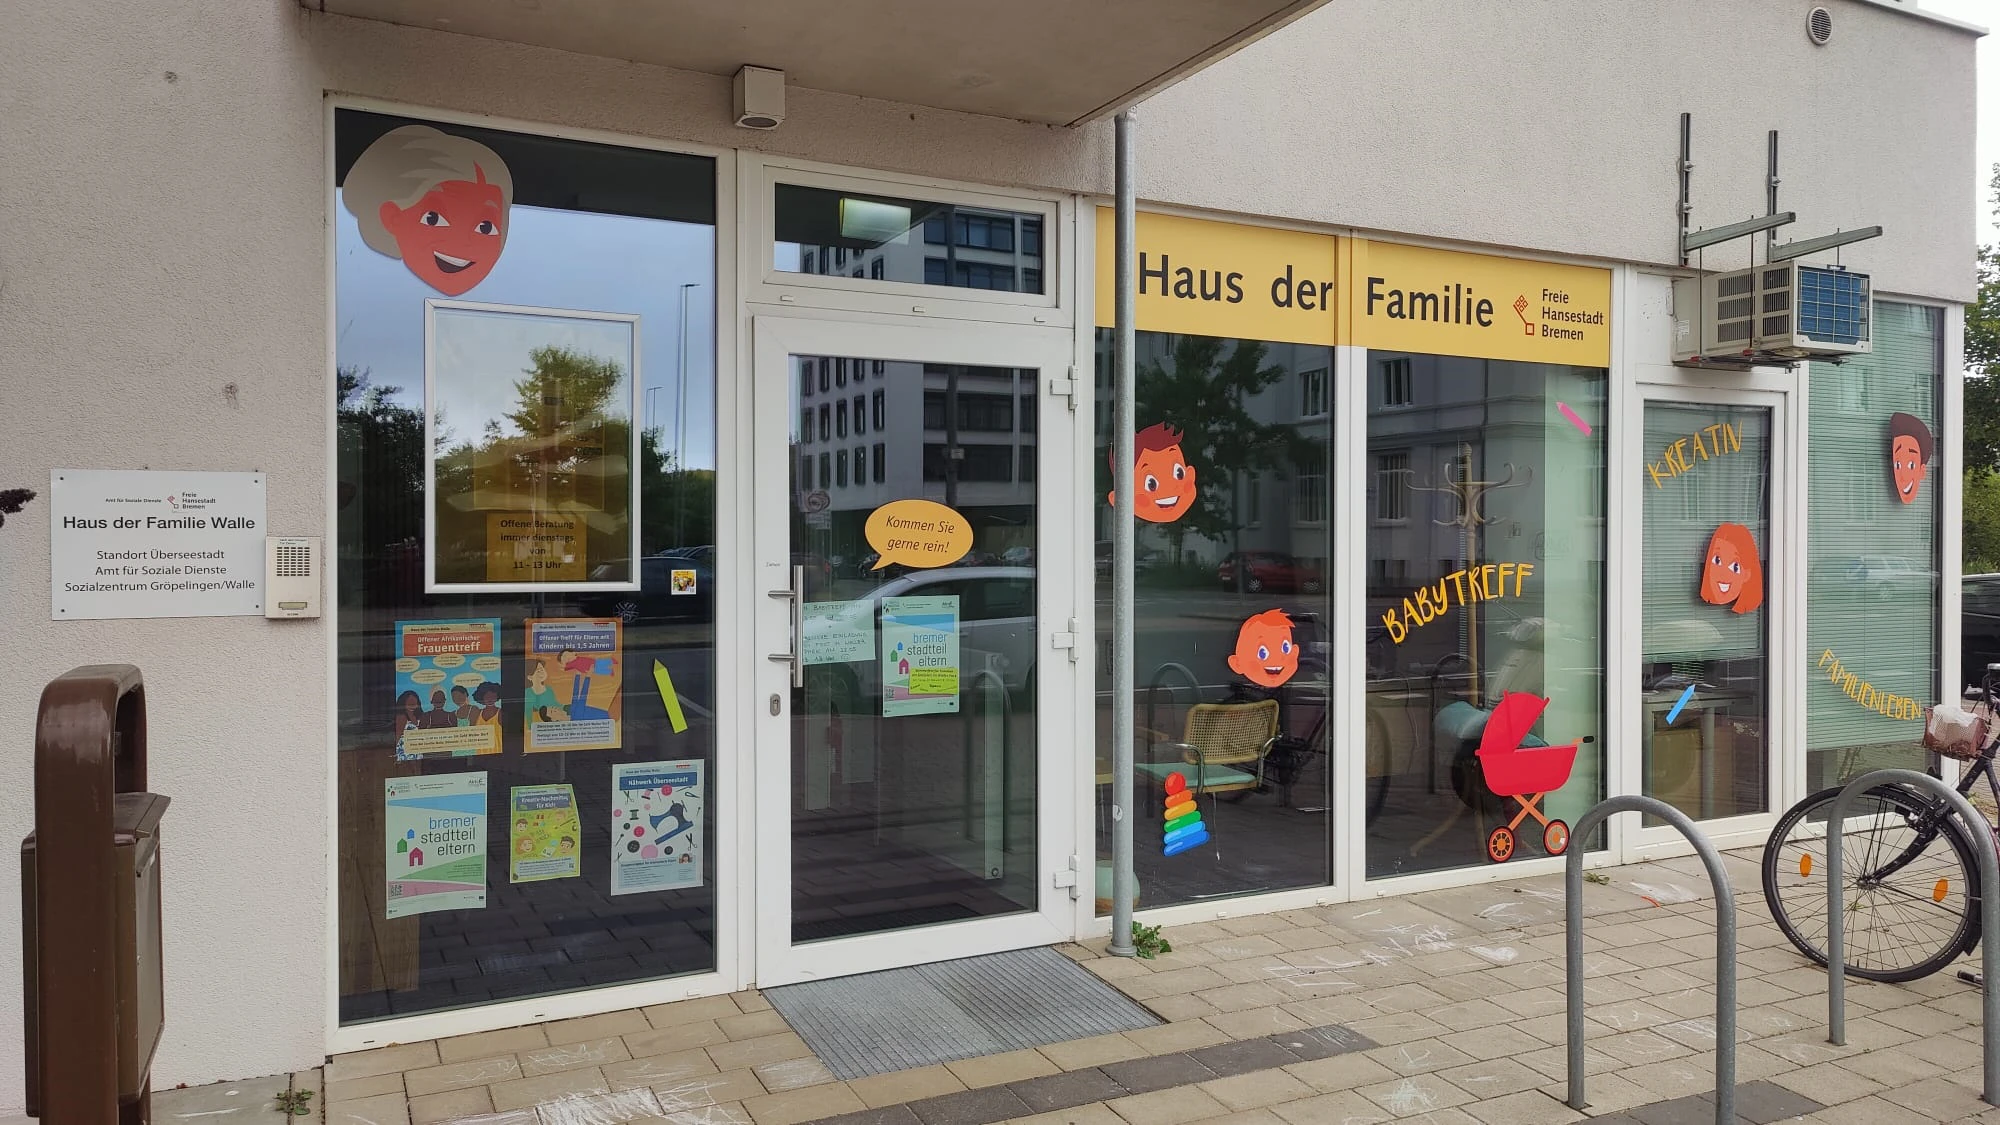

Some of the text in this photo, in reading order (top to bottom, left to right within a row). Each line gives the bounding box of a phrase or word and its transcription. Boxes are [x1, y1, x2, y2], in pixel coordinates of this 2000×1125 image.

[1139, 252, 1494, 327] Haus der Familie
[1541, 288, 1569, 304] Freie
[1541, 306, 1604, 326] Hansestadt
[1541, 324, 1584, 341] Bremen
[1647, 421, 1744, 489] KREATIV
[63, 516, 255, 529] Haus der Familie Walle
[500, 520, 574, 530] Offene Beratung
[886, 515, 955, 534] Kommen Sie
[887, 537, 950, 553] gerne rein!
[97, 548, 225, 561] Standort Überseestadt
[95, 565, 227, 576] Amt für Soziale Dienste
[545, 561, 562, 569] Uhr
[65, 579, 255, 594] Sozialzentrum Gröpelingen/Walle
[1382, 562, 1535, 645] BABYTREFF
[913, 632, 946, 644] bremer
[417, 641, 481, 653] Frauentreff
[907, 643, 947, 656] stadtteil
[918, 656, 947, 667] eltern
[1818, 648, 1923, 721] FAMILIENLEBEN
[429, 816, 477, 830] bremer
[420, 827, 476, 844] stadtteil
[437, 843, 476, 856] eltern
